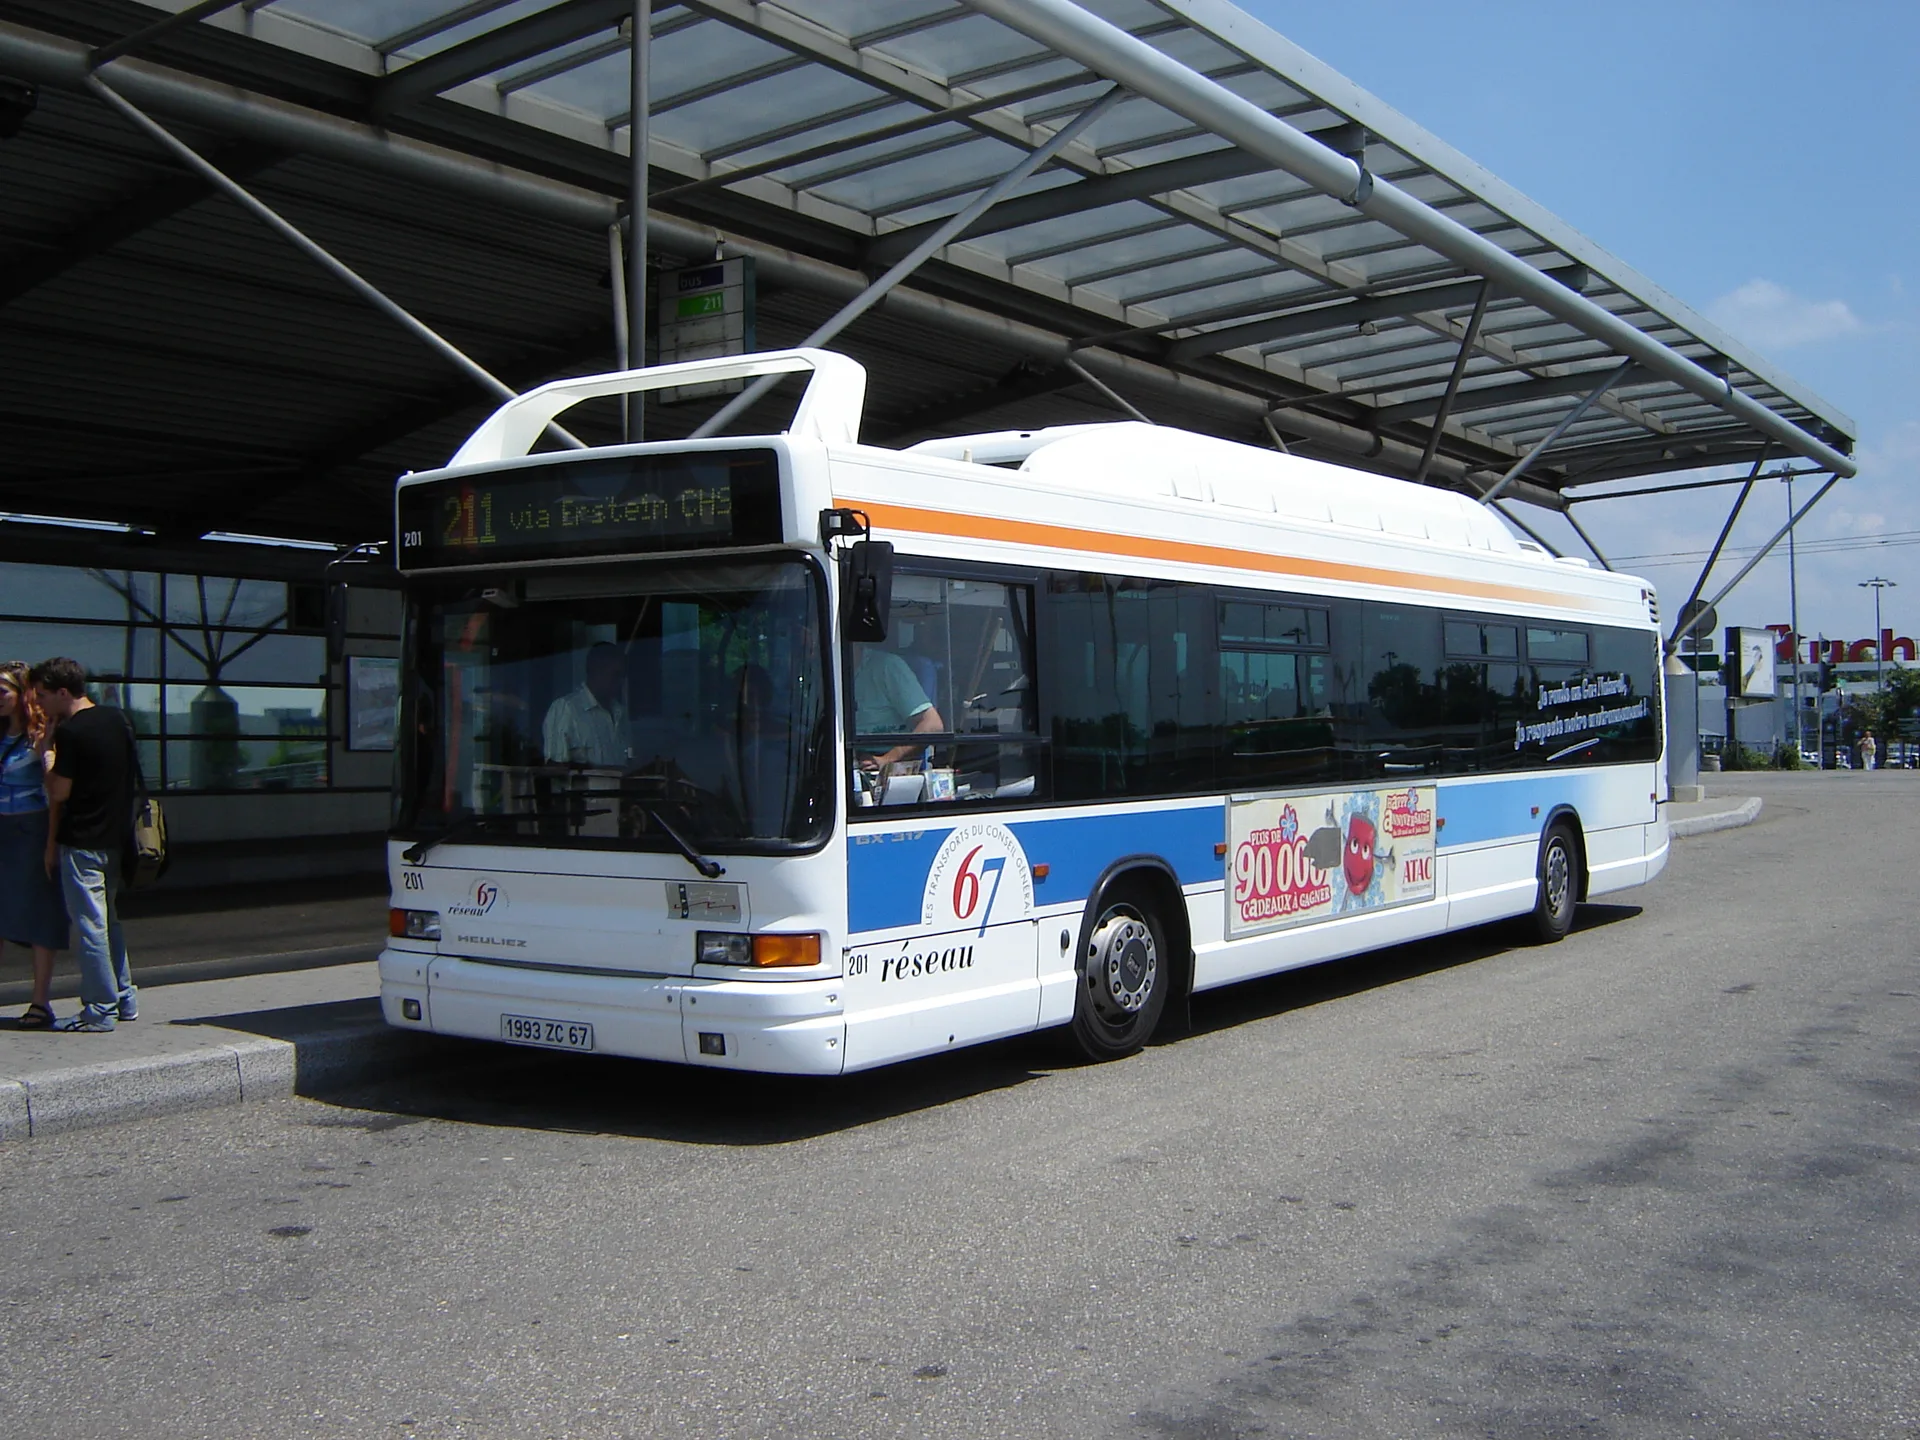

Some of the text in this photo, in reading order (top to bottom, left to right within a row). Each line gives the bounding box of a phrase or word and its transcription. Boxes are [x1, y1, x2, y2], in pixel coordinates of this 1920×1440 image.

[680, 274, 702, 289] bus
[703, 295, 722, 310] 211
[443, 493, 496, 545] 211
[510, 503, 549, 530] via
[682, 486, 731, 517] CHS
[404, 531, 422, 547] 201
[971, 824, 984, 837] DU
[986, 825, 1017, 858] CONSEIL
[1251, 829, 1281, 846] PLUS DE
[929, 828, 969, 897] TRANSPORTS
[1402, 856, 1433, 884] ATAC
[403, 872, 424, 891] 201
[952, 844, 1007, 938] 67
[447, 902, 484, 916] réseau
[477, 882, 498, 914] 67
[1292, 891, 1299, 909] À
[1299, 886, 1330, 908] GAGNER
[925, 903, 934, 926] LES
[457, 934, 528, 948] HEULIEZ
[849, 941, 975, 982] 201 réseau
[506, 1019, 588, 1046] 1993 ZC 67
